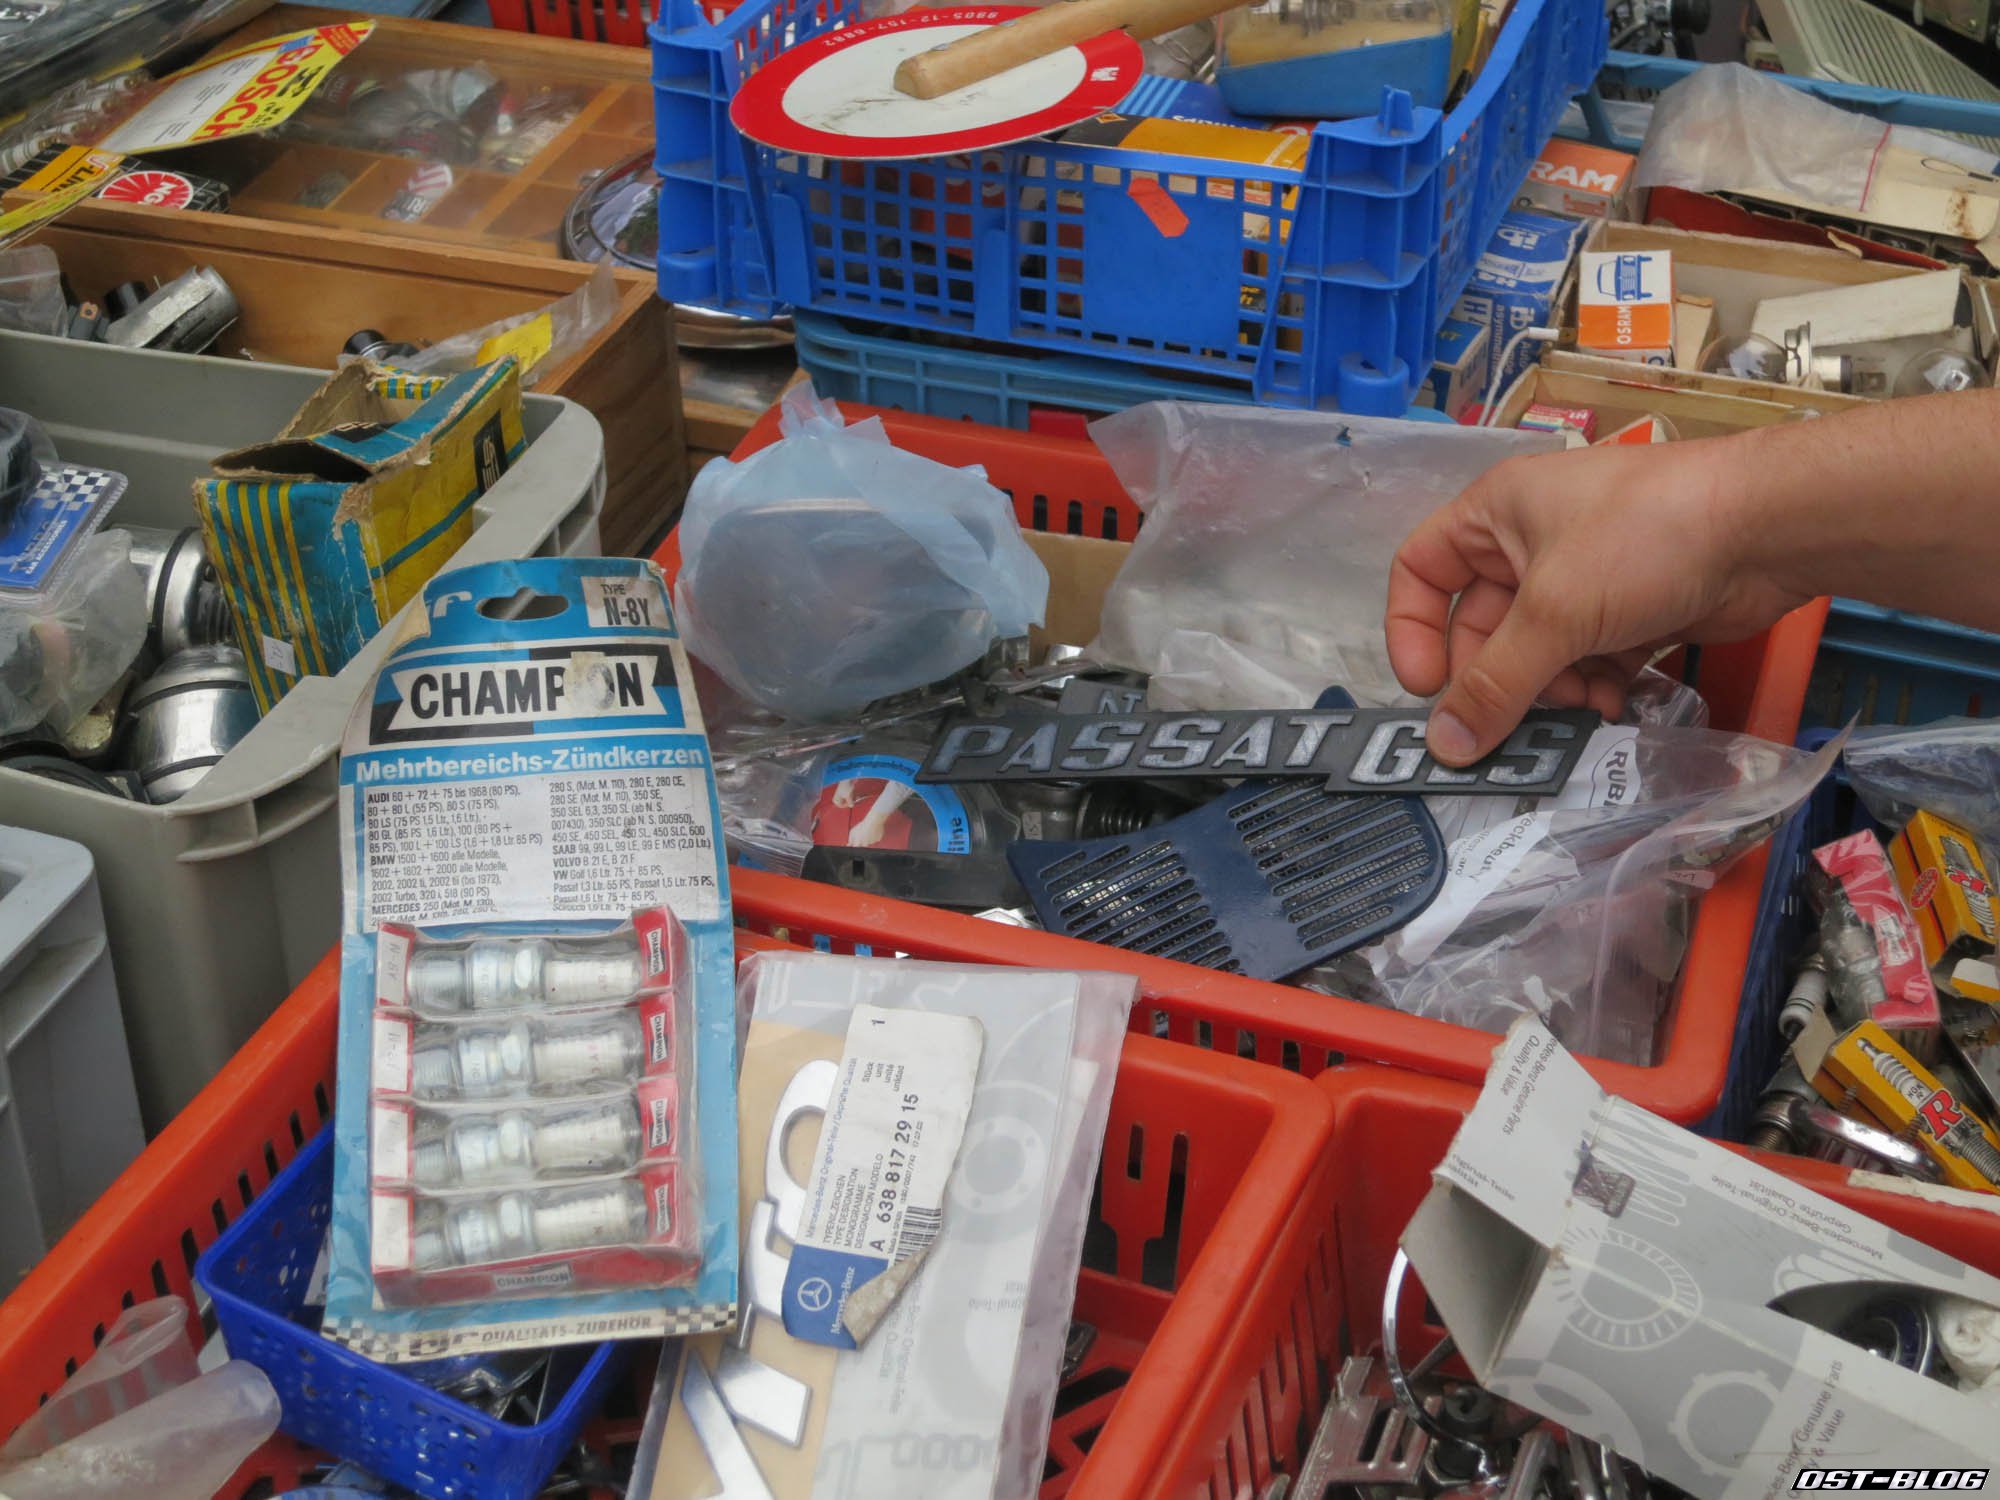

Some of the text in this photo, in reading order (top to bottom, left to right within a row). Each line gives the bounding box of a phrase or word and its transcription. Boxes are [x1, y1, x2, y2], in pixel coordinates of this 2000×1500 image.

[192, 44, 324, 141] BOSCH
[1531, 160, 1618, 192] RAM
[1616, 303, 1632, 345] OSRAM
[601, 584, 625, 595] TYPE
[603, 598, 650, 626] N-8Y
[410, 661, 645, 720] CHAMPN
[929, 712, 1354, 775] PASSAT
[356, 745, 705, 784] Mehrbereichs-Zündkerzen
[368, 793, 390, 803] AUDI
[417, 790, 428, 800] 72
[442, 788, 453, 798] 75
[371, 856, 395, 866] BMW
[552, 844, 576, 855] SAAB
[553, 856, 582, 868] VOLVO
[553, 870, 568, 880] VW
[634, 878, 660, 888] Passat
[688, 876, 699, 886] 75
[372, 903, 420, 914] MERCEDES
[651, 931, 662, 973] CHAMPION
[653, 1015, 665, 1061] CHAMPION
[872, 1018, 886, 1026] 1
[1515, 1034, 1540, 1067] Quality
[876, 1062, 885, 1079] unit
[902, 1094, 920, 1113] 15
[1919, 1089, 1964, 1141] R
[894, 1119, 913, 1145] 29
[868, 1153, 884, 1191] MODELO
[885, 1148, 906, 1183] 817
[838, 1167, 859, 1224] DESIGNATION
[876, 1188, 897, 1224] 638
[844, 1183, 866, 1247] MONOGRAMME
[869, 1239, 886, 1252] A
[497, 1267, 571, 1289] CHAMPION
[481, 1315, 652, 1344] QUALITÄTS-ZUBEHÖR
[1796, 1389, 1833, 1443] Genuine
[1817, 1407, 1846, 1445] Value
